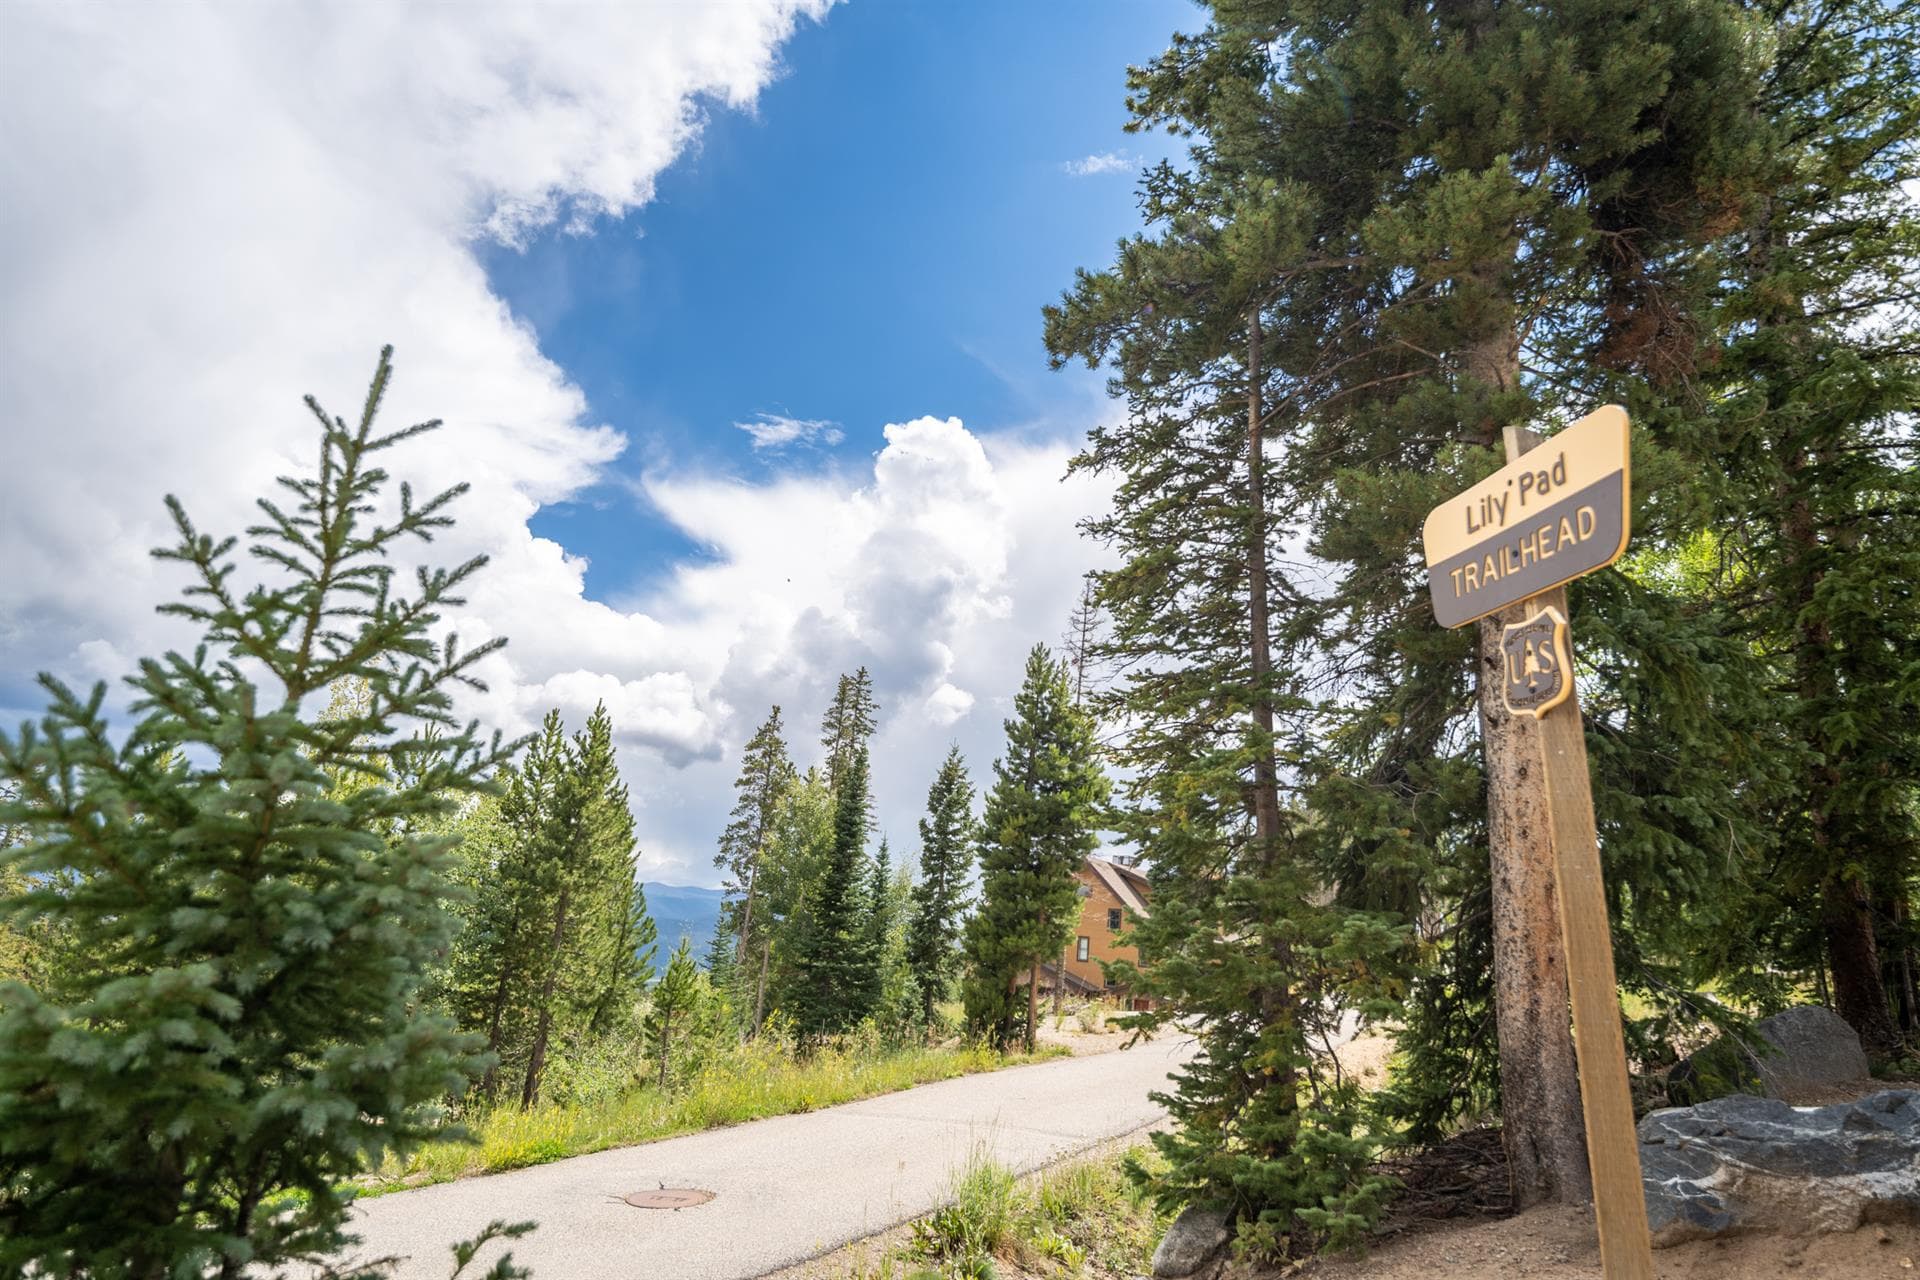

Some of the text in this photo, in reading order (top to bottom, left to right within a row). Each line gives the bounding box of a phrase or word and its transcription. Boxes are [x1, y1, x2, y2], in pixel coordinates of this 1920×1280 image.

[1466, 451, 1567, 535] Lily Pad
[1449, 505, 1597, 598] TRAILHEAD
